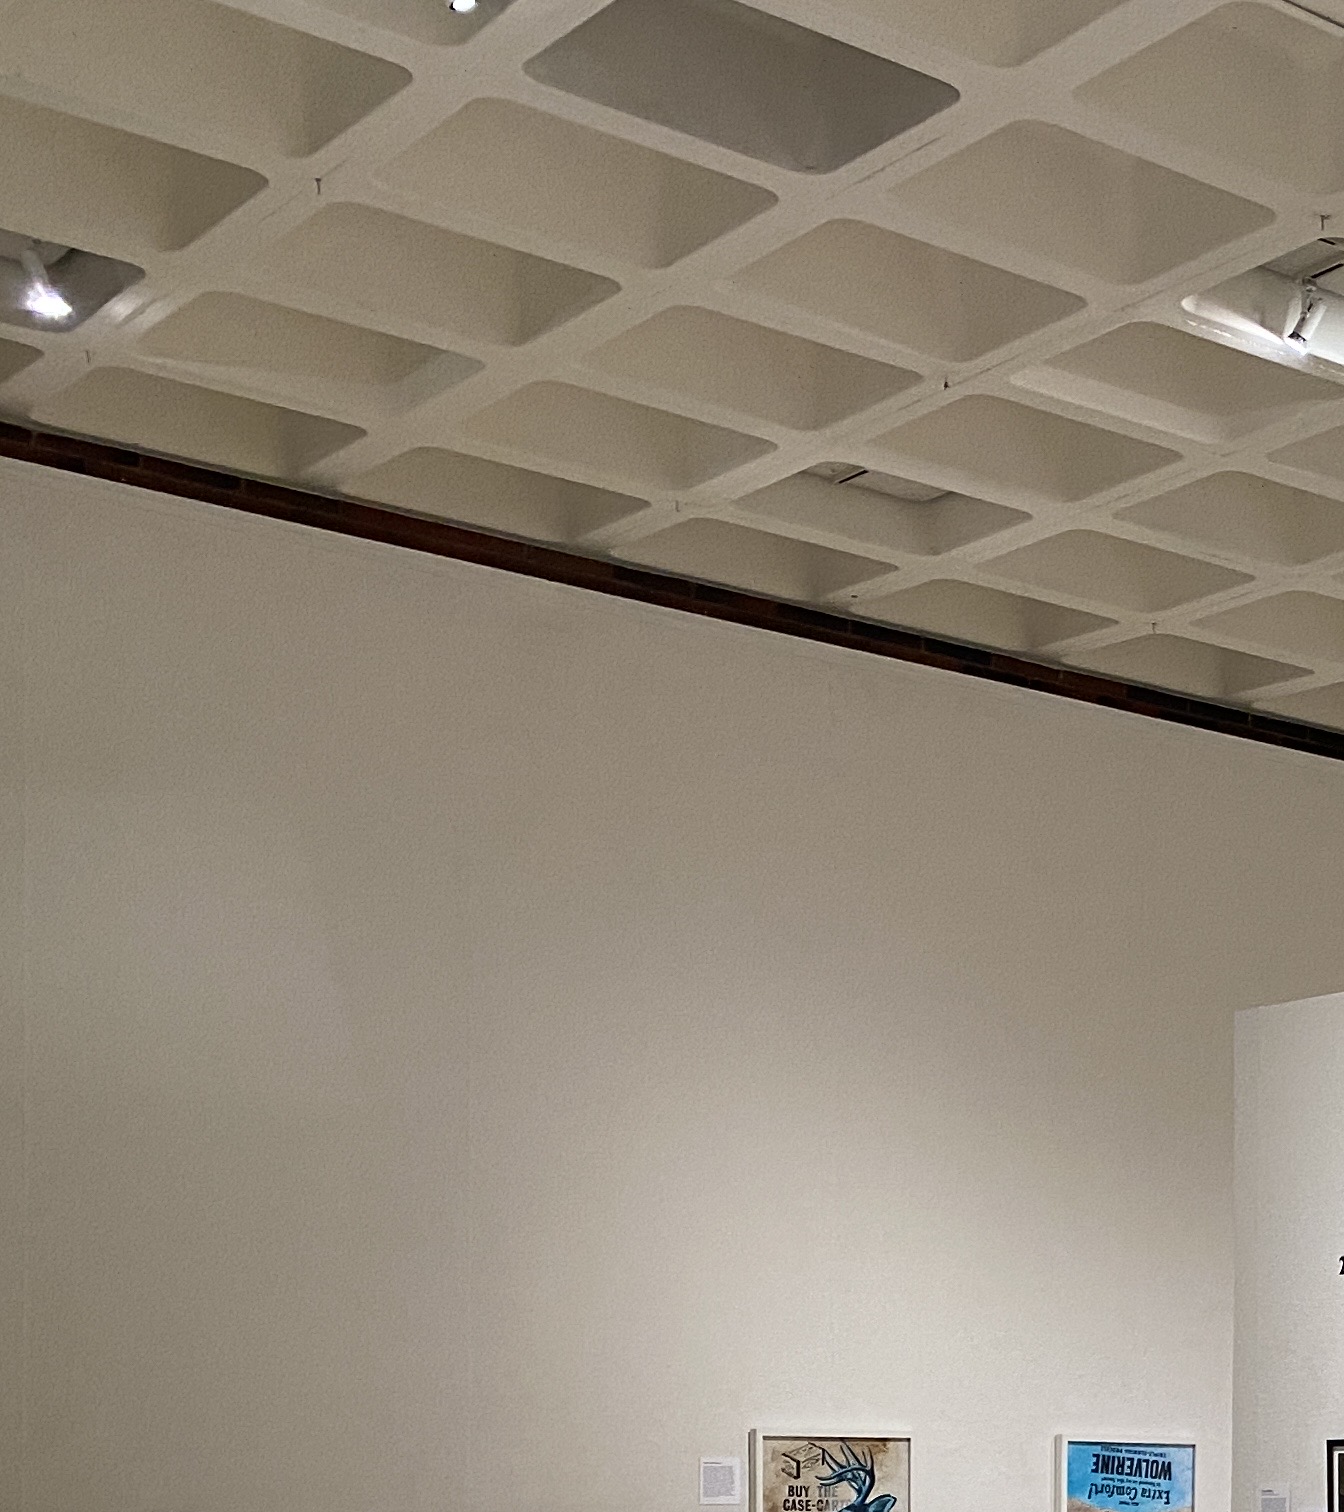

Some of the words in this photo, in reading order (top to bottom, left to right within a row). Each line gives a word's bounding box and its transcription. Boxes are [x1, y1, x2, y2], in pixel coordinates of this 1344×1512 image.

[1091, 1453, 1172, 1482] WOLVERINE
[787, 1485, 810, 1498] BUY
[817, 1485, 838, 1498] THE
[1088, 1483, 1138, 1501] Comfort!
[1141, 1487, 1171, 1505] Extra
